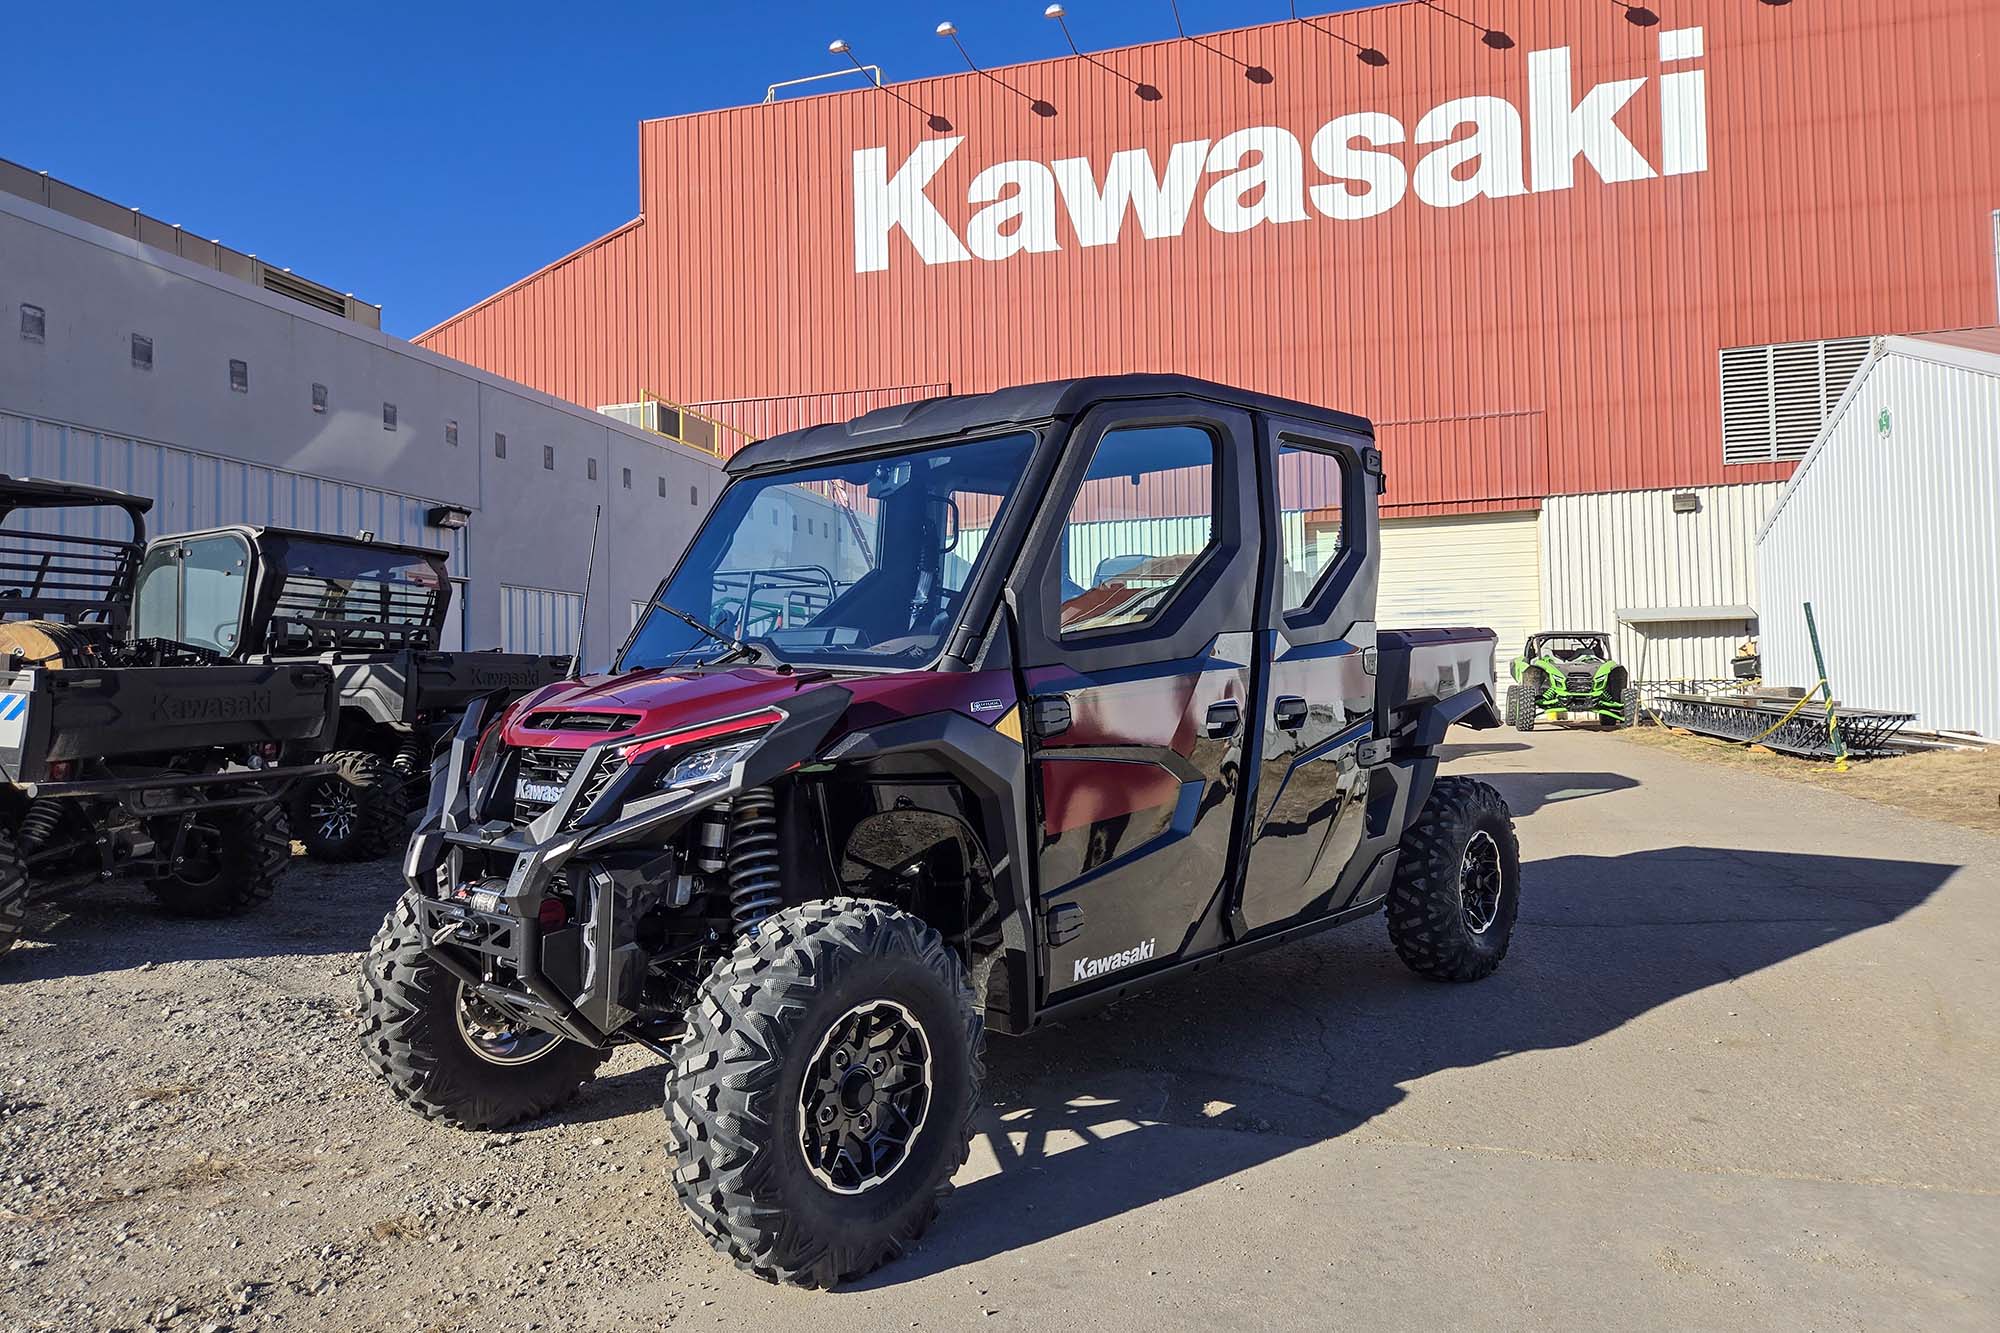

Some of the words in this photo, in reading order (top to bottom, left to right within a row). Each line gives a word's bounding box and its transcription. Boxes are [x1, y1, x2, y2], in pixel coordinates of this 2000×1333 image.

[852, 26, 1708, 274] Kawasaki
[472, 665, 540, 686] Kawasaki
[152, 689, 271, 720] Kawasaki
[514, 778, 566, 803] Kawas
[1073, 937, 1156, 982] Kawasaki
